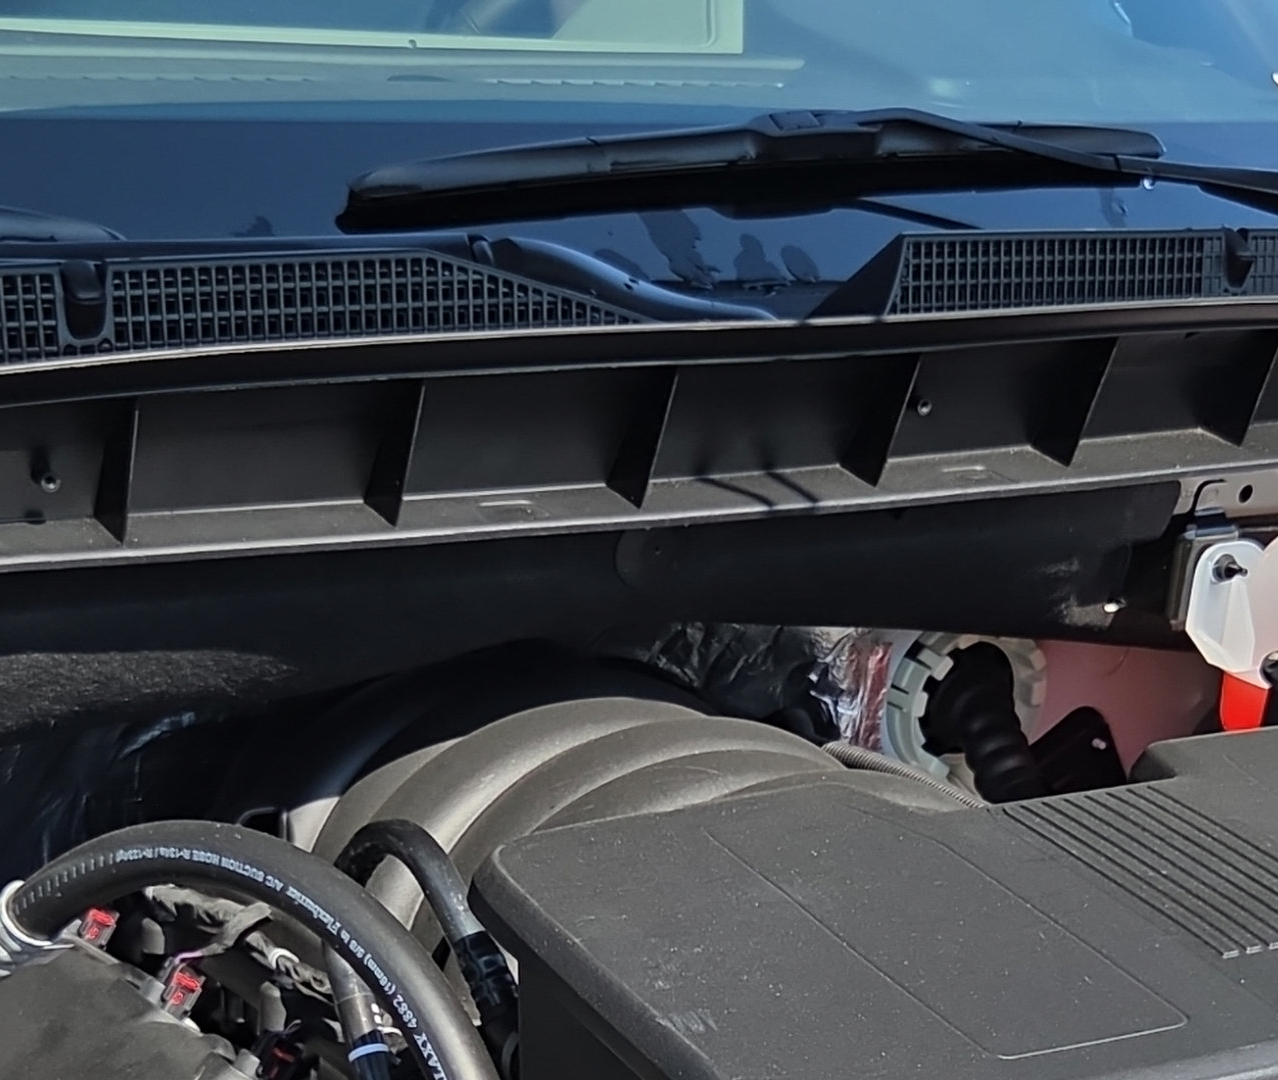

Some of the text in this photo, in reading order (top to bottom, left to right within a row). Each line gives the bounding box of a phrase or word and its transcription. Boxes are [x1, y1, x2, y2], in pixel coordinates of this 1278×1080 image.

[192, 850, 220, 865] HOSE
[221, 856, 265, 882] SUCTION
[265, 875, 284, 892] A/C
[340, 929, 350, 943] in
[349, 939, 365, 958] 5/8
[364, 953, 396, 994] (16mm)
[393, 995, 417, 1027] 4882
